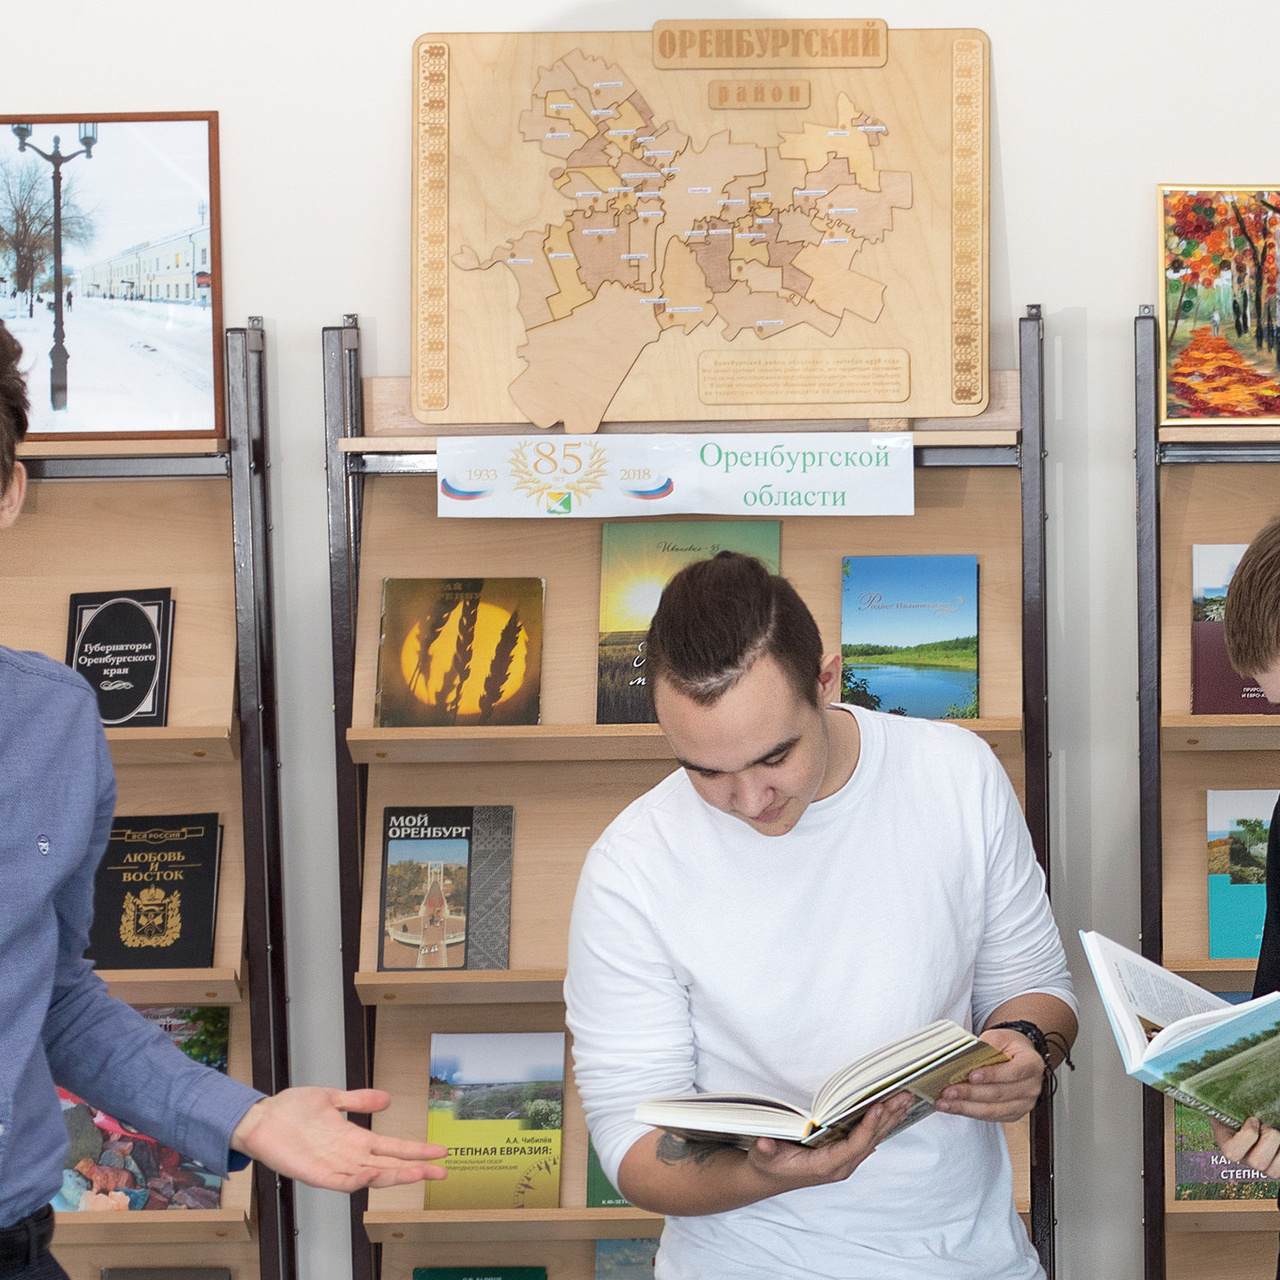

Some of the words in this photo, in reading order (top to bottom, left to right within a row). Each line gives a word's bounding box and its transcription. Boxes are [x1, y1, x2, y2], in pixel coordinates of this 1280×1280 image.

[658, 21, 880, 59] ОРЕНБУРГСКИЙ
[718, 83, 801, 106] район
[533, 441, 582, 475] 85
[700, 442, 890, 473] Оренбургской
[467, 469, 498, 481] 1933
[619, 469, 651, 481] 2018
[743, 484, 846, 507] области
[84, 643, 152, 654] Губернаторы
[78, 654, 156, 667] Оренбургского
[103, 667, 129, 677] края
[389, 813, 428, 827] МОЙ
[149, 832, 181, 840] РОССИЯ
[388, 826, 470, 838] ОРЕНБУРГ
[123, 851, 186, 863] ЛЮБОВЬ
[149, 862, 159, 872] И
[122, 870, 184, 882] ВОСТОК
[521, 1136, 552, 1144] Чибилёв
[447, 1147, 497, 1156] СТЕПНАЯ
[500, 1146, 552, 1156] ЕВРАЗИЯ:
